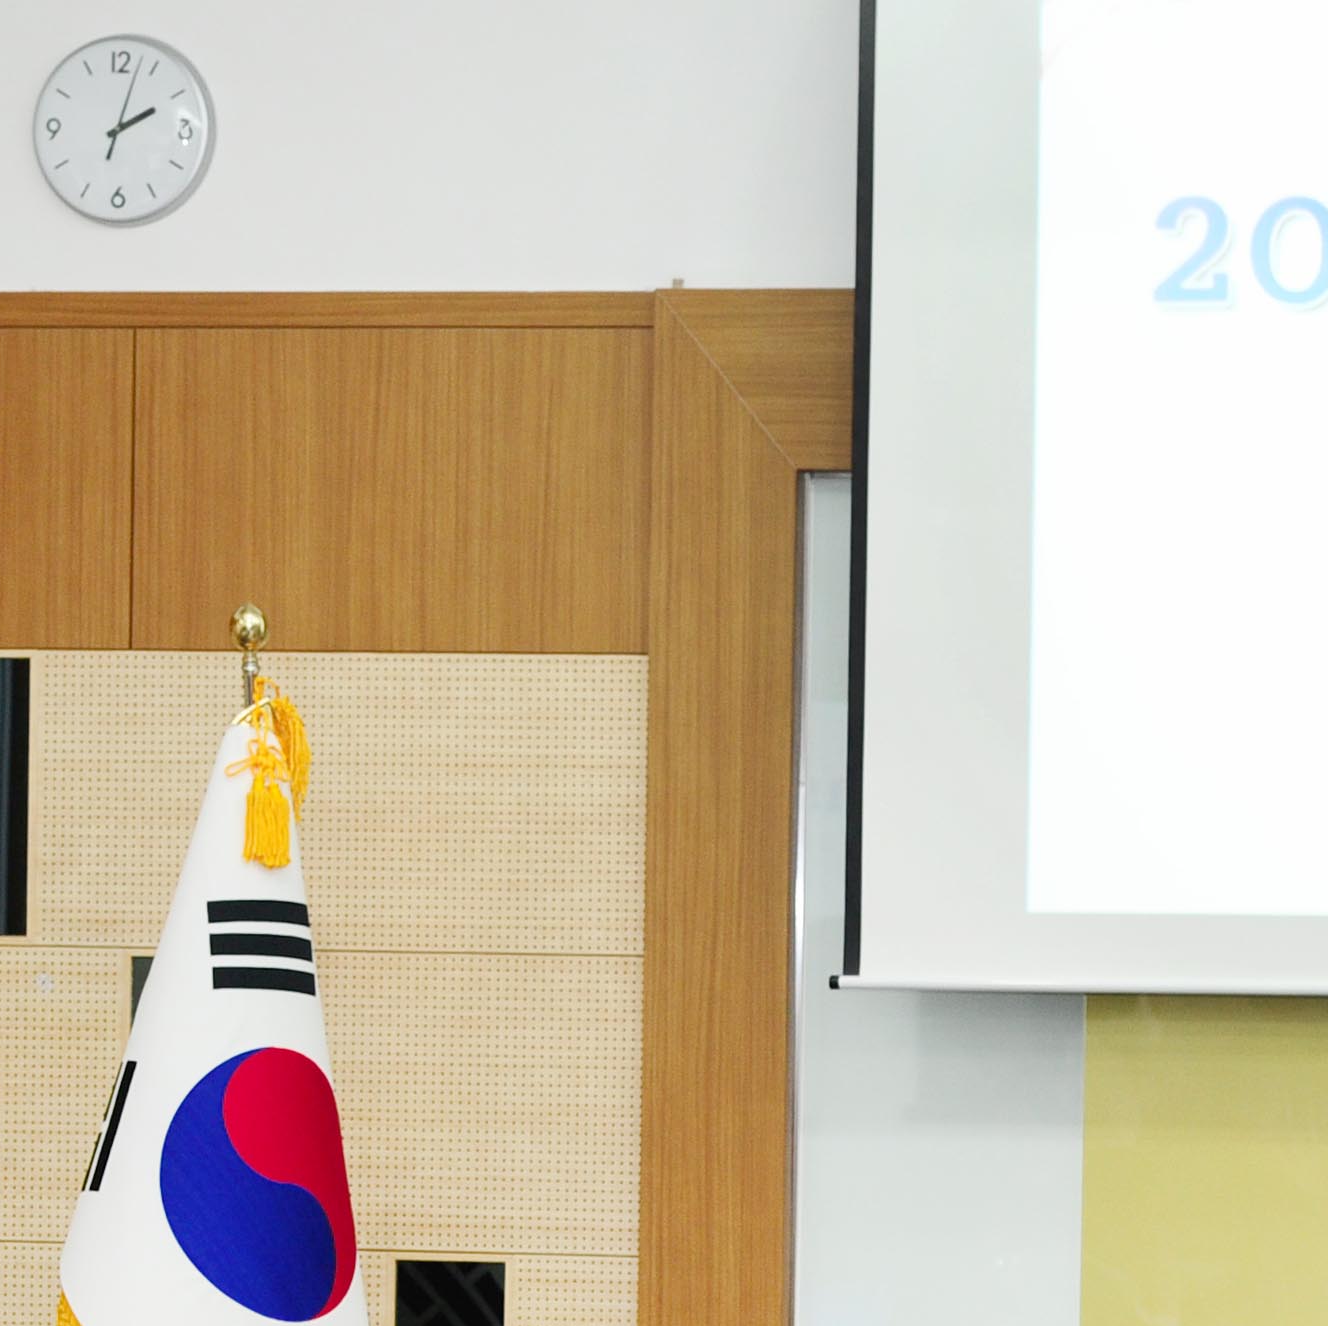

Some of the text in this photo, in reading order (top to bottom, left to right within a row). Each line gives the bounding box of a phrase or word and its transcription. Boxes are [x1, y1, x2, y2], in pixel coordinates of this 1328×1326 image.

[111, 51, 131, 73] 12
[46, 117, 62, 141] 9
[177, 118, 193, 141] 3
[110, 186, 126, 208] 6
